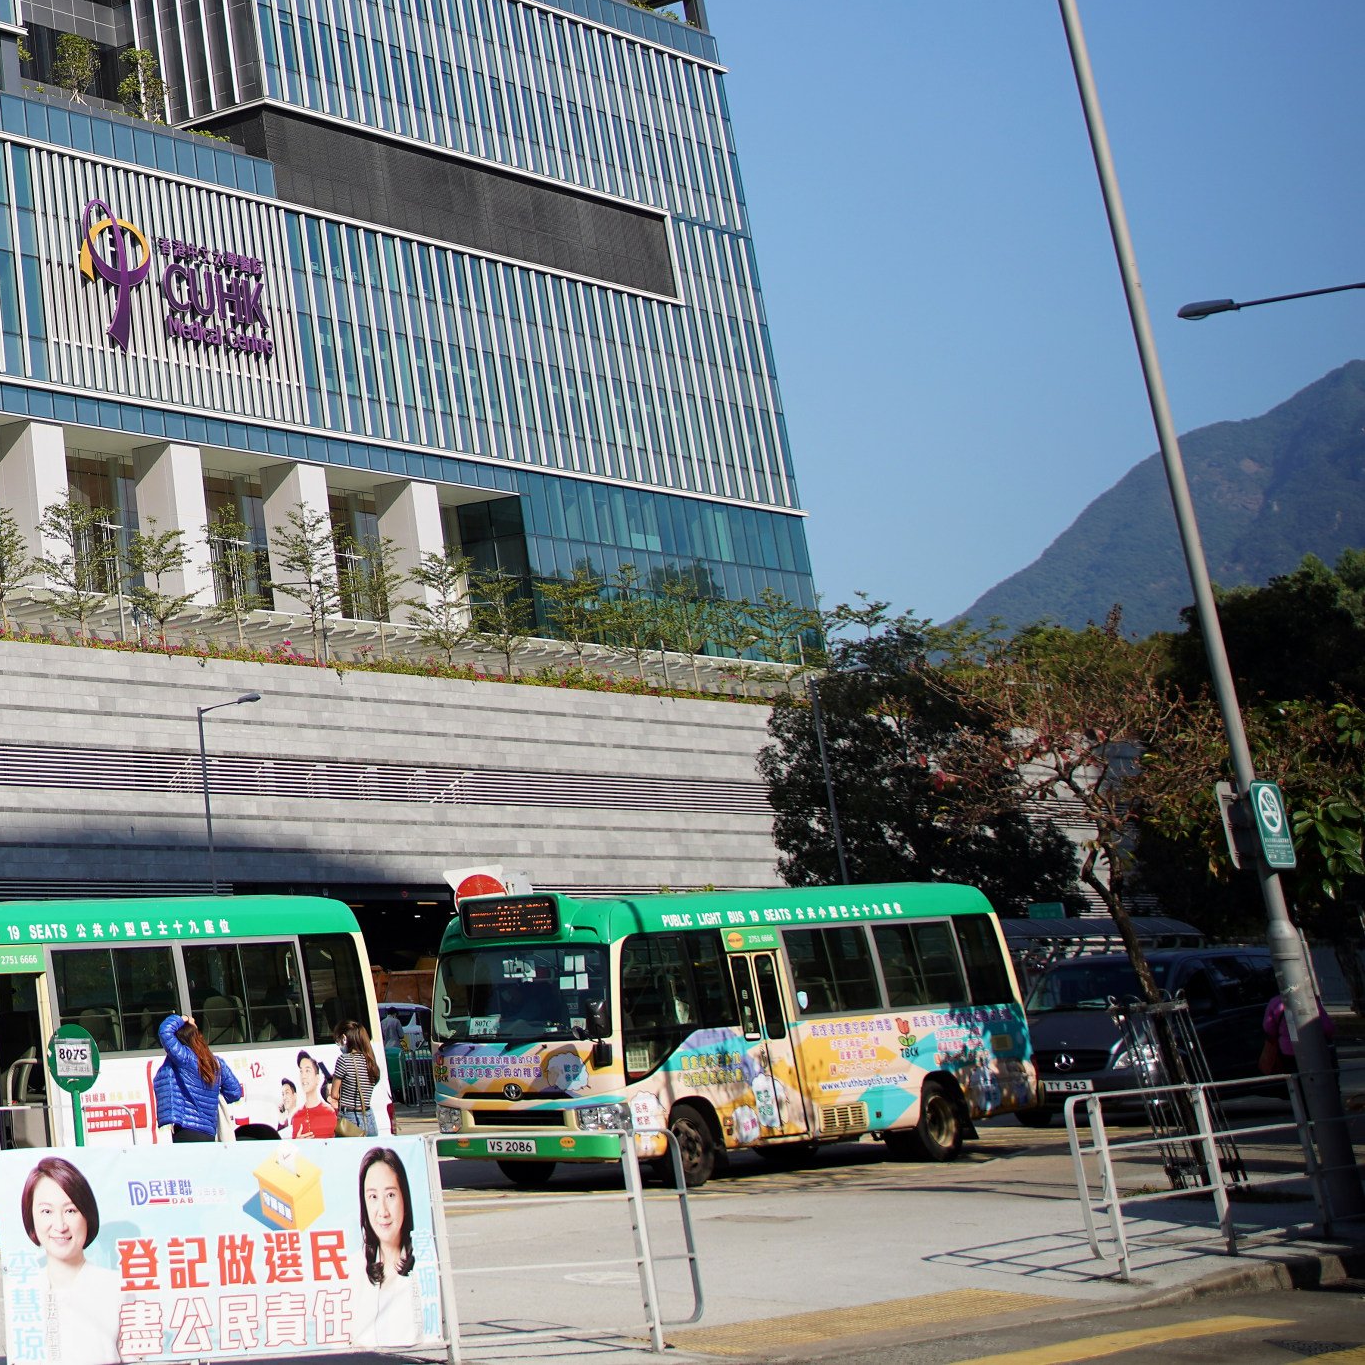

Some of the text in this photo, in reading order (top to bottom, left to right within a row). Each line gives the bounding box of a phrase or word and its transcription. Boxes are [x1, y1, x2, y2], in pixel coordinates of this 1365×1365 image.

[158, 237, 263, 275] 香港中文大學醫院
[162, 263, 270, 329] CUHK
[167, 315, 274, 356] Medical Centre
[661, 913, 693, 927] PUBLIC
[696, 911, 722, 925] LIGHT
[727, 910, 745, 924] BUS
[749, 910, 760, 922] 19
[763, 908, 792, 921] SEATS
[7, 925, 20, 940] 19
[29, 923, 68, 939] SEATS
[75, 921, 231, 938] 公共小型巴士十九座位
[1, 954, 38, 965] 2751 6666
[1048, 1082, 1060, 1090] TY
[489, 1141, 532, 1152] VS 2086
[148, 1179, 193, 1197] 民建聯
[118, 1230, 349, 1292] 登記做選民
[119, 1288, 353, 1356] 盡公民責任
